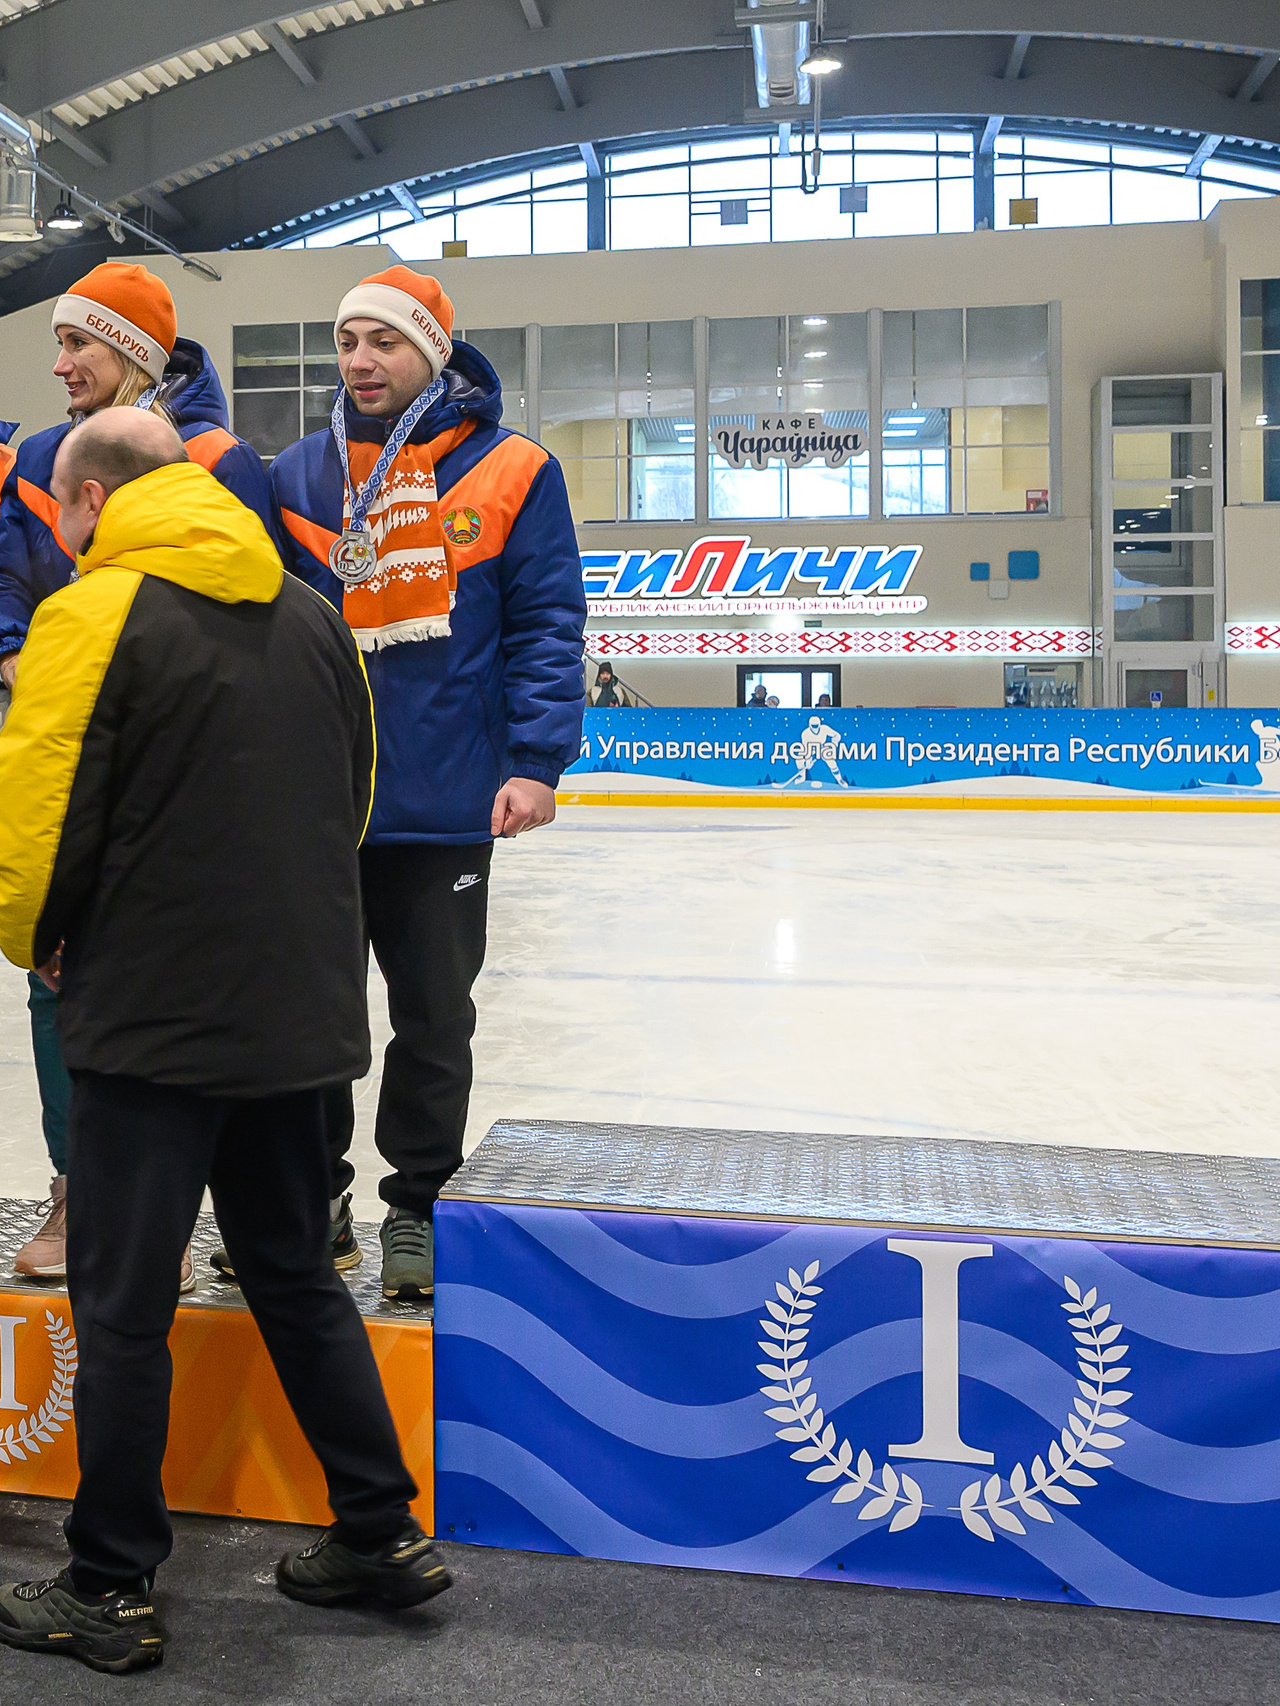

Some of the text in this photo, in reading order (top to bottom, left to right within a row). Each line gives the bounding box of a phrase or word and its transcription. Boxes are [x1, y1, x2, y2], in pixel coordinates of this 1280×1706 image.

[86, 313, 149, 362] БЕЛАРУСЬ
[411, 308, 451, 362] БЕЛАРУС
[761, 418, 816, 431] КАФЕ
[717, 430, 862, 465] Чараўніца
[868, 599, 923, 613] ЦЕНТР
[597, 734, 764, 765] Управления
[770, 741, 878, 765] делами
[885, 736, 1060, 767] Президента
[1068, 737, 1250, 769] Республики
[1259, 738, 1280, 765] Б
[458, 873, 479, 885] NIKE
[886, 1237, 995, 1466] I
